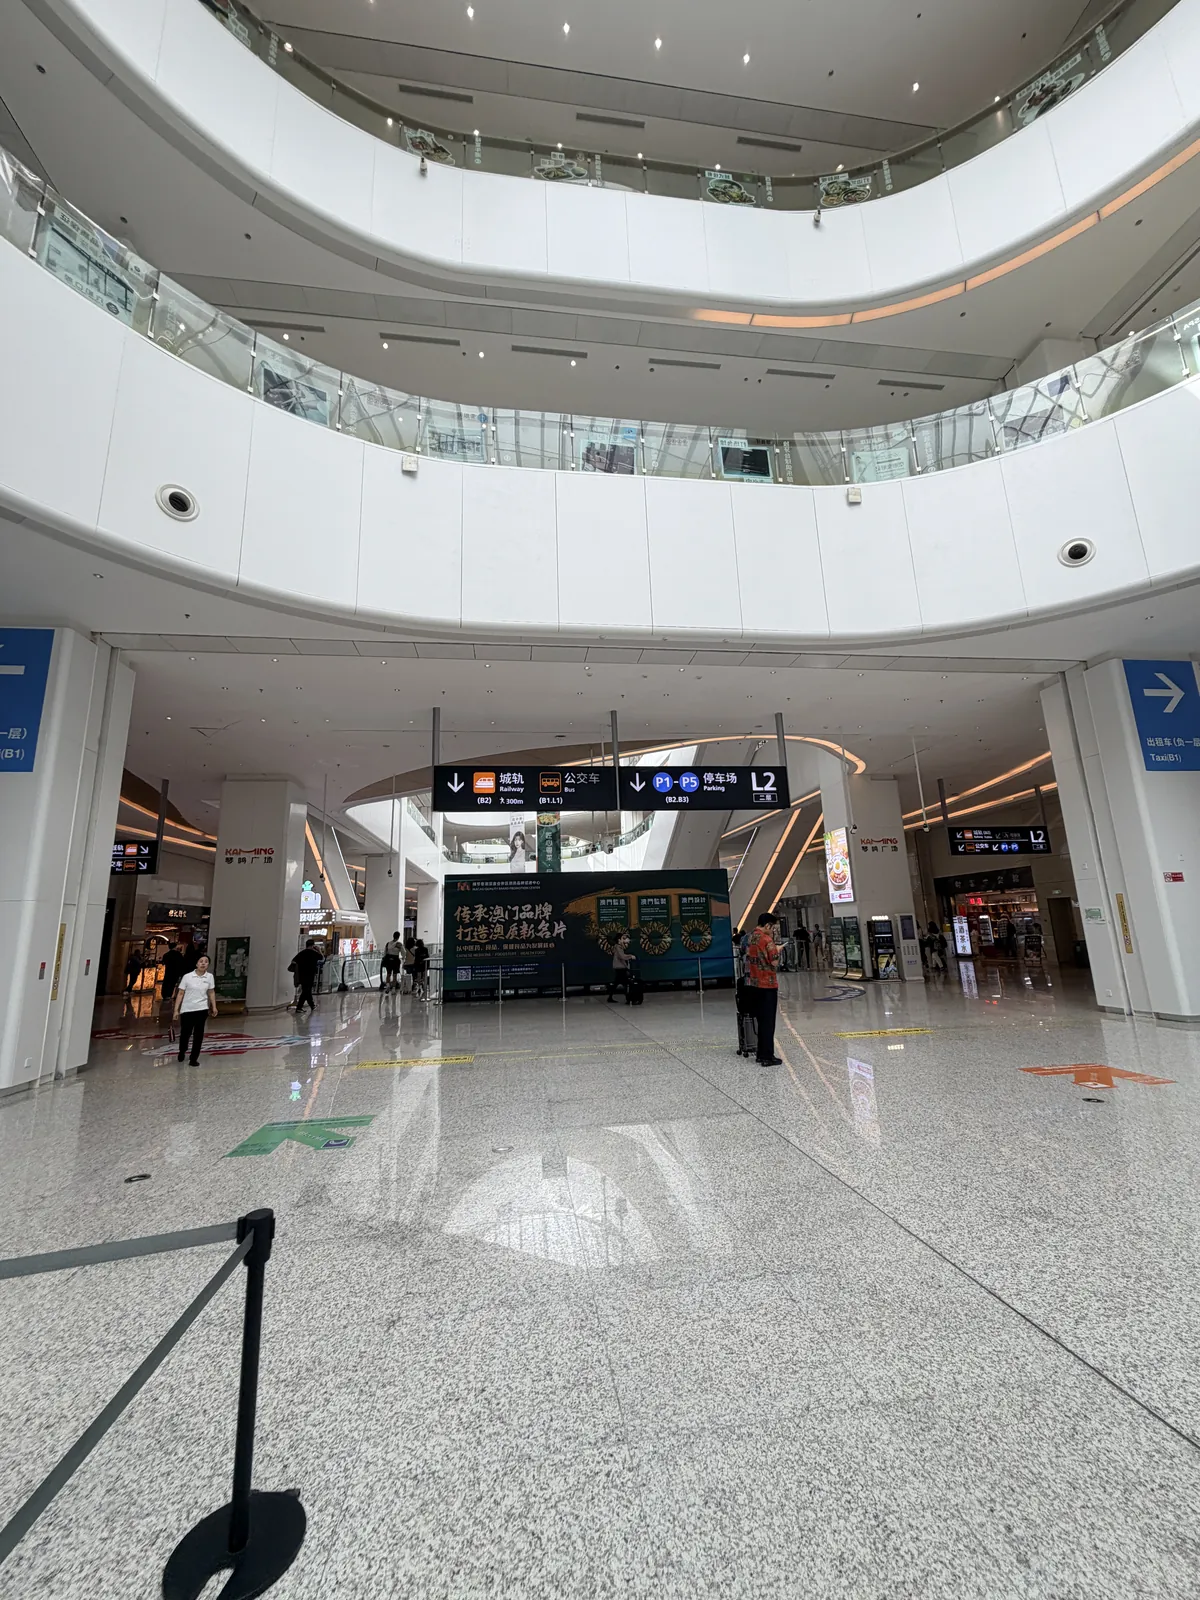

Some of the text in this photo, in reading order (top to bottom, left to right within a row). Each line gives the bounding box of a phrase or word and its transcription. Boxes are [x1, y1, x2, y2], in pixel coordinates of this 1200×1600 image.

[0, 748, 25, 761] (B1)
[499, 772, 525, 785] 城轨
[564, 772, 600, 785] 公交车
[703, 772, 737, 784] 停车场
[751, 771, 777, 791] L2
[499, 786, 525, 794] Railway
[477, 797, 492, 805] (B2)
[1030, 830, 1046, 843] L2
[454, 902, 553, 923] 传承澳门品牌
[456, 920, 568, 943] 打造澳质新名片
